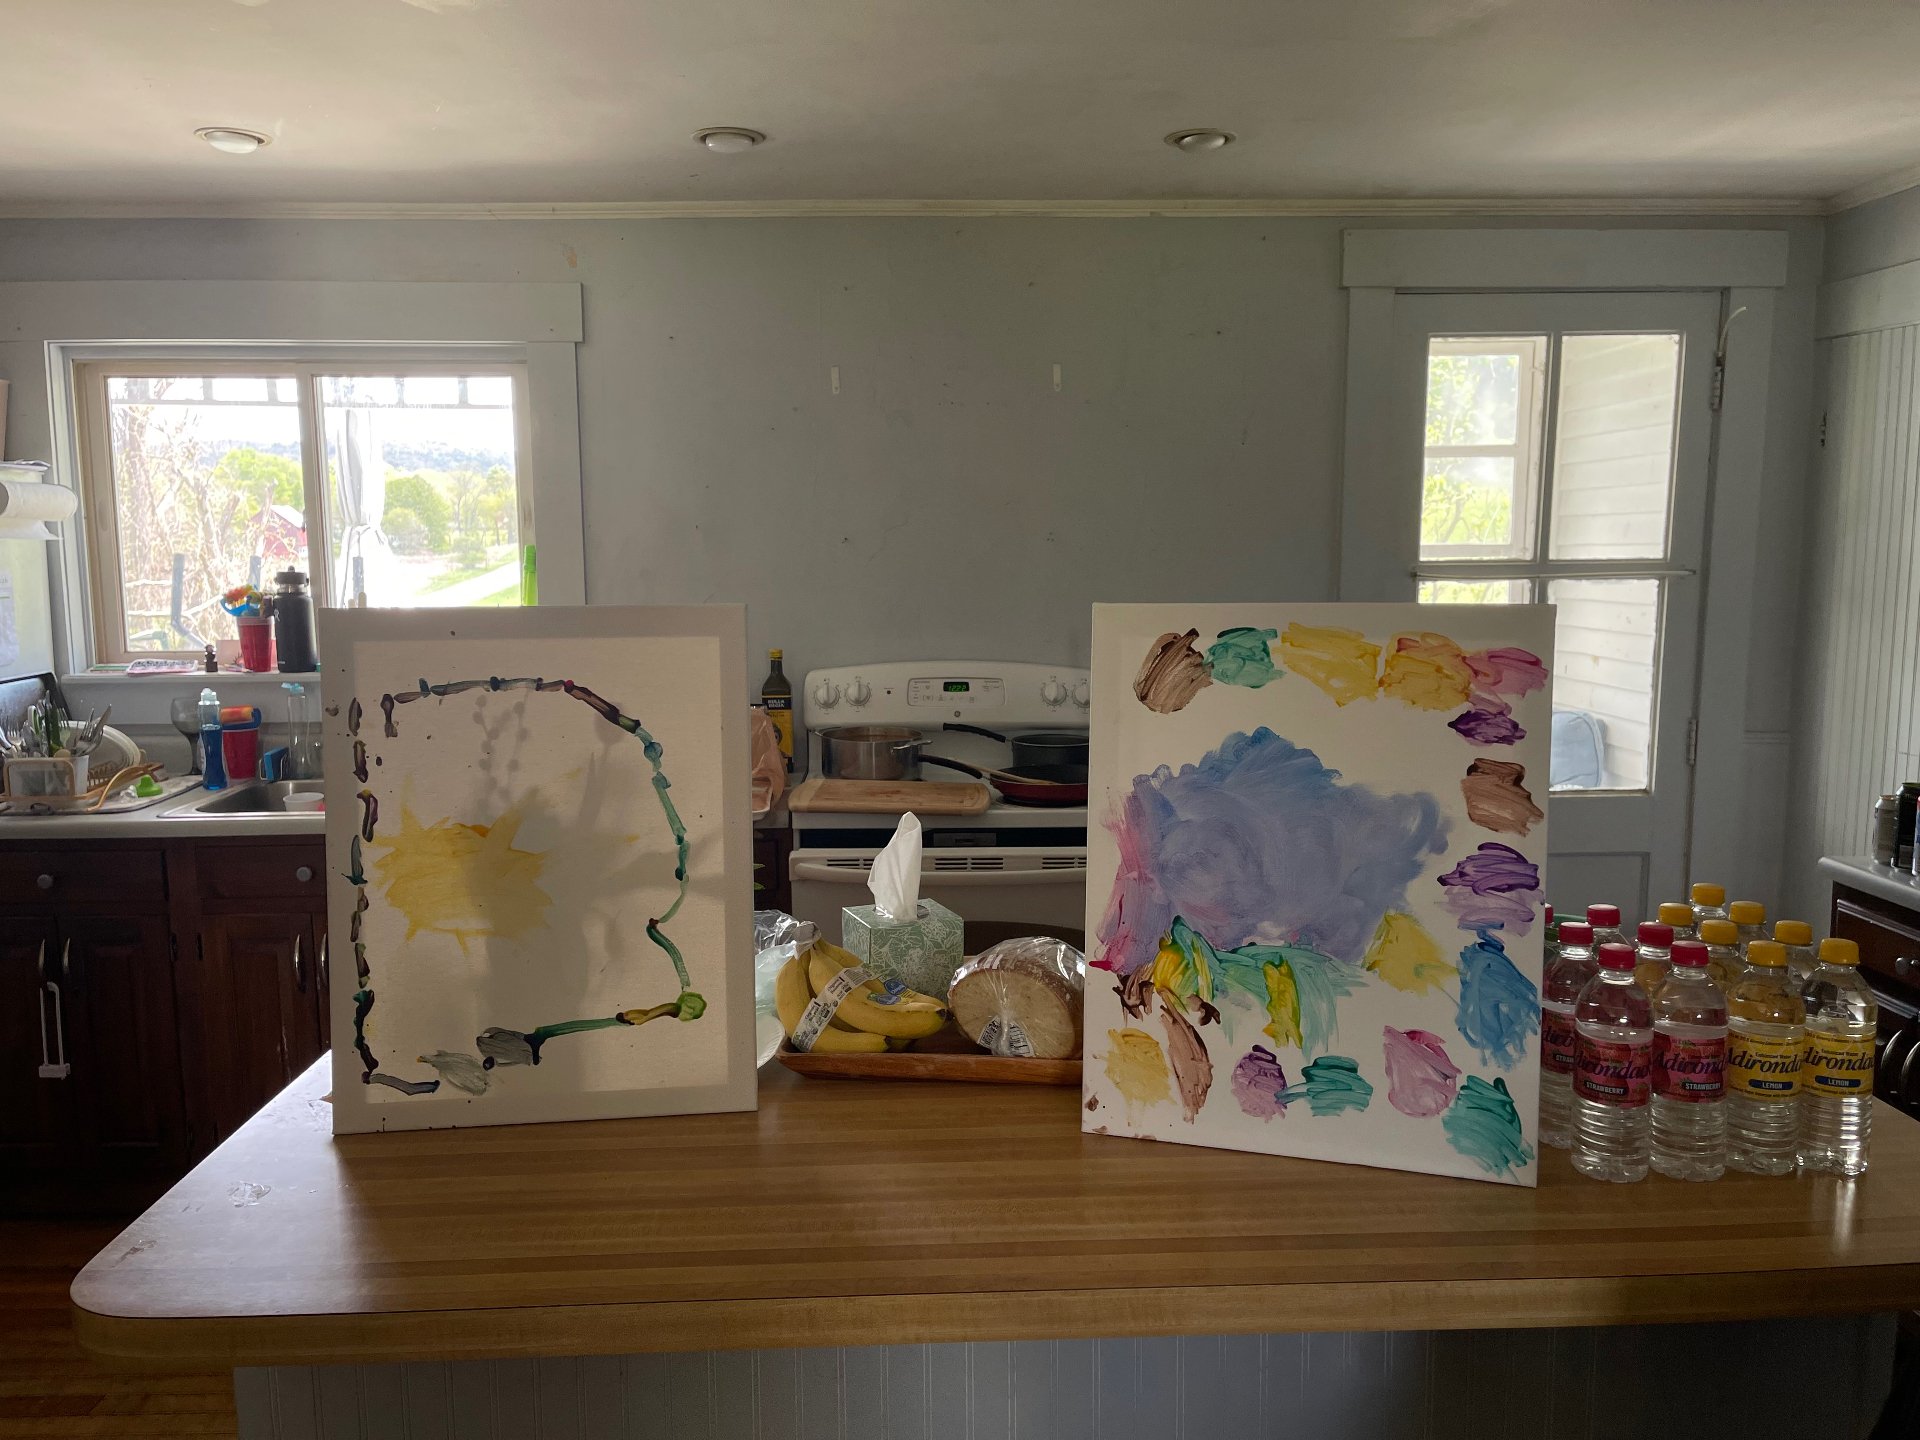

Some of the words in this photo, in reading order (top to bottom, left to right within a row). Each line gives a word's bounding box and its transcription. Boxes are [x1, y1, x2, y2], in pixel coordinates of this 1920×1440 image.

[1762, 1082, 1783, 1090] LEMON
[1828, 1078, 1850, 1087] LEMON
[1586, 1081, 1625, 1095] STRAWBERRY
